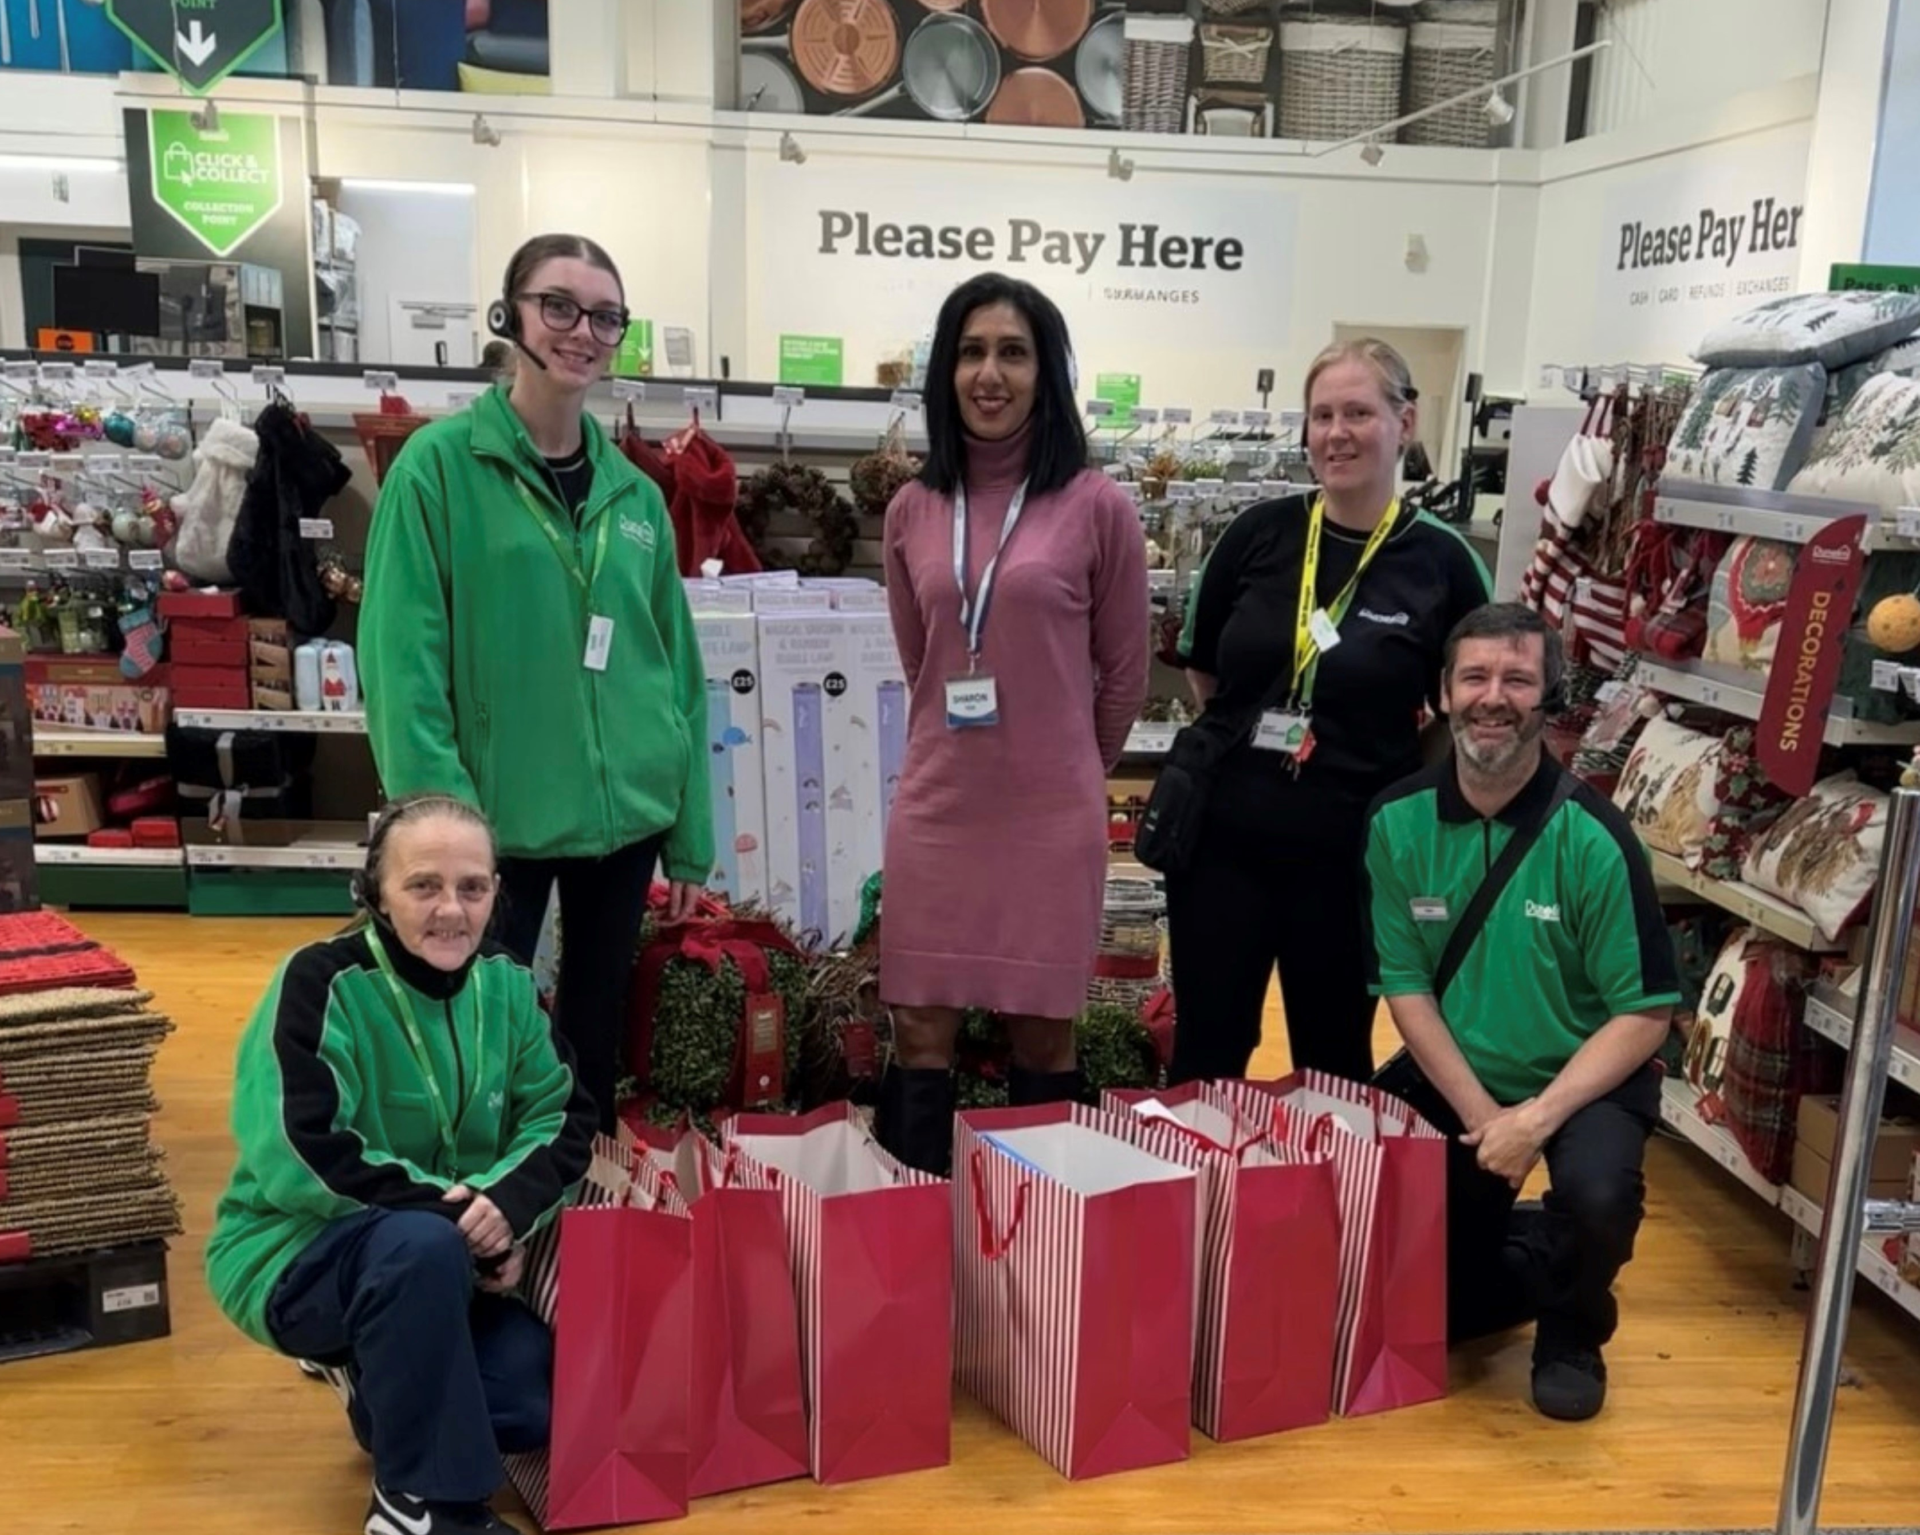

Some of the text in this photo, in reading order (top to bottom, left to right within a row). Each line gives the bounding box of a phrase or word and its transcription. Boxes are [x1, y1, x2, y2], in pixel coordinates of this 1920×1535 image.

[195, 152, 258, 168] CLICK &
[195, 166, 270, 184] COLLECT
[183, 201, 254, 213] COLLECTION
[202, 214, 237, 226] POINT
[1617, 197, 1803, 270] Please Pay Her
[818, 210, 1244, 275] Please Pay Here
[1629, 276, 1790, 305] CASH CARD REFUNDS EXCHANGES
[1779, 591, 1831, 751] DECORATIONS
[733, 674, 753, 688] £25
[826, 677, 846, 690] £25
